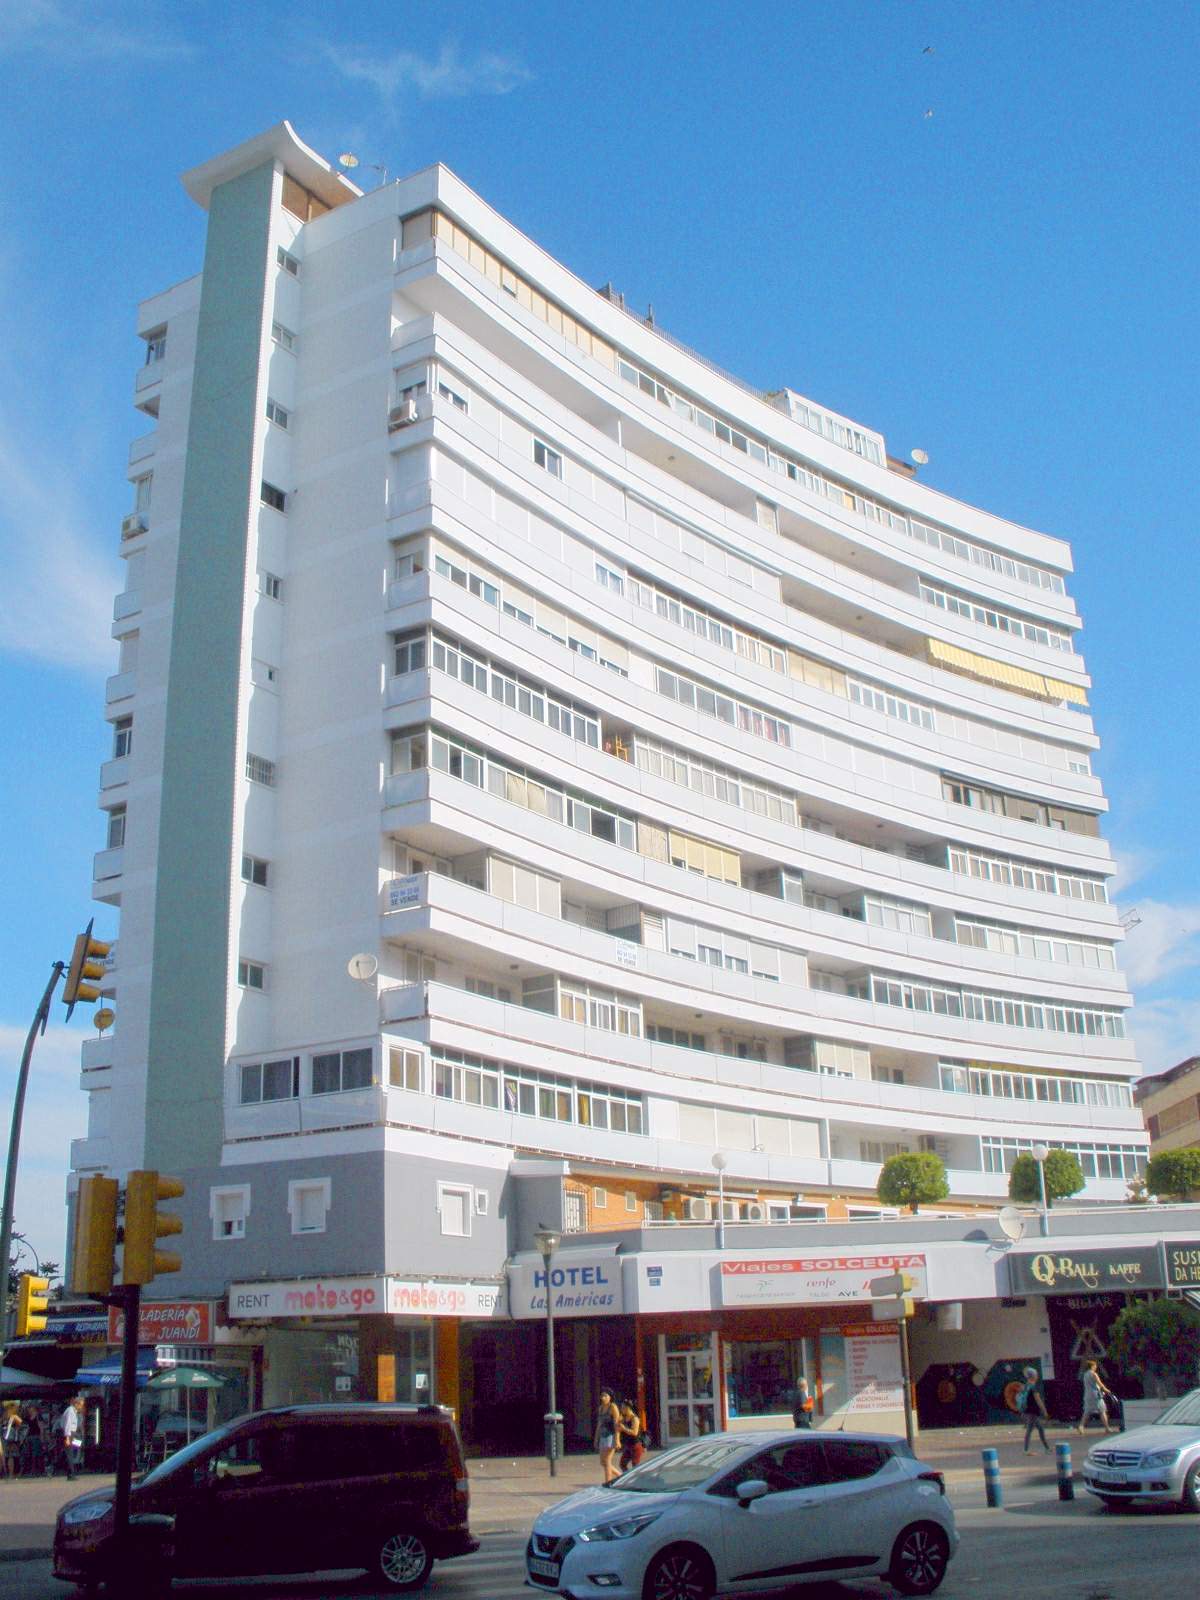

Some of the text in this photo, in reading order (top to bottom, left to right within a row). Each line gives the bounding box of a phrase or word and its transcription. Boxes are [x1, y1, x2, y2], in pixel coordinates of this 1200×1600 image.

[724, 1256, 925, 1274] Viajes SOLCEUTA
[534, 1266, 609, 1288] HOTEL
[1175, 1267, 1188, 1281] DA
[806, 1276, 836, 1289] renfe
[237, 1285, 376, 1311] RENT moto&go
[393, 1285, 502, 1310] moto&go RENT
[555, 1292, 614, 1307] Américas
[838, 1289, 859, 1297] AVE
